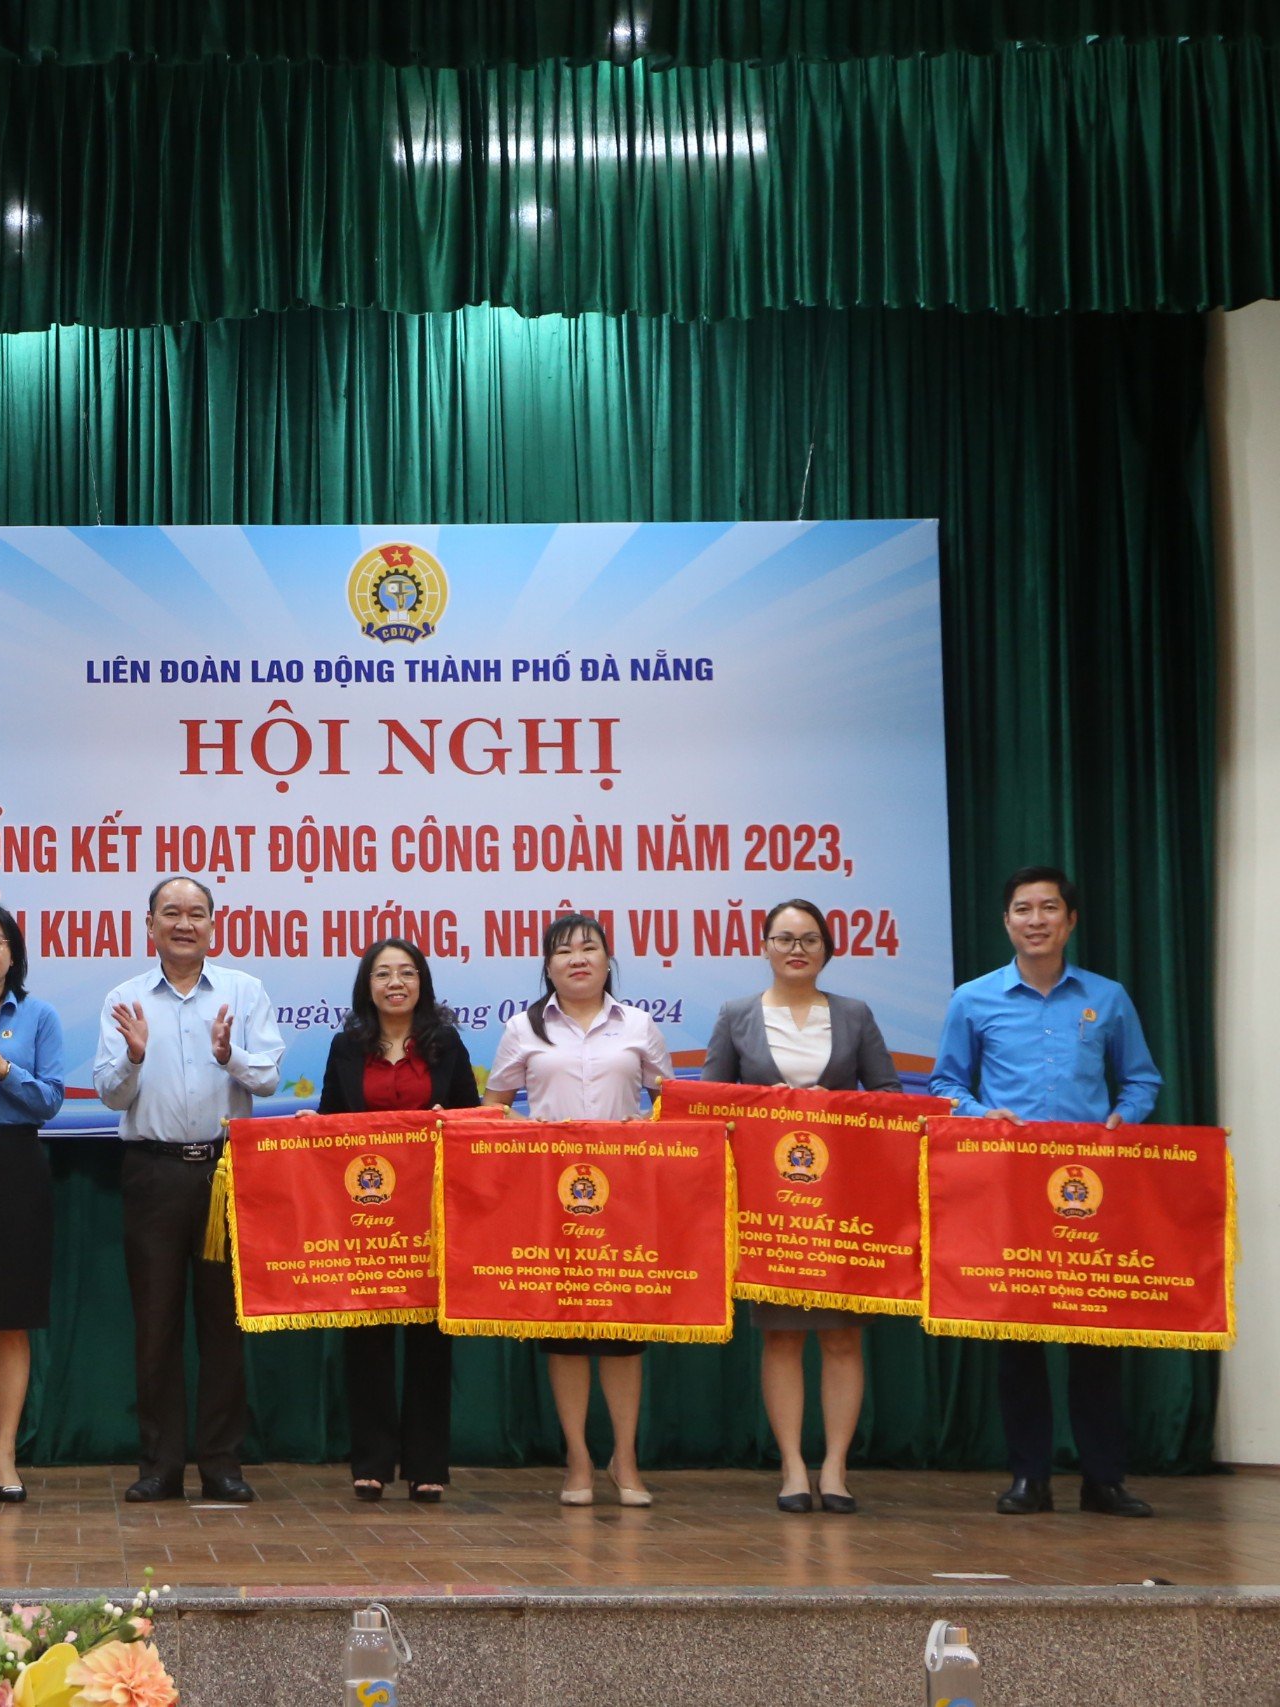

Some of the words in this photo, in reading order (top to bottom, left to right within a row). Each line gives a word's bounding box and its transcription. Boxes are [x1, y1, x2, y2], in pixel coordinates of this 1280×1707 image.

[382, 627, 415, 639] CĐVN
[87, 656, 150, 683] LIÊN
[160, 655, 240, 683] ĐOÀN
[252, 660, 303, 683] LAO
[314, 655, 394, 688] ĐỘNG
[405, 655, 501, 682] THÀNH
[513, 654, 570, 681] PHỐ
[580, 659, 620, 681] ĐÀ
[631, 653, 713, 681] NẴNG
[179, 700, 350, 793] HỘI
[378, 717, 621, 790] NGHỊ
[73, 810, 141, 872] KẾT
[157, 826, 255, 883] HOẠT
[269, 815, 376, 883] ĐỘNG
[393, 815, 499, 872] CÔNG
[514, 815, 622, 871] ĐOÀN
[638, 814, 729, 870] NĂM
[744, 824, 854, 877] 2023,
[42, 910, 132, 957] KHAI
[147, 905, 308, 957] ƯƠNG
[323, 900, 470, 963] HƯỚNG,
[628, 909, 679, 967] VỤ
[825, 909, 899, 956] 024
[277, 999, 350, 1029] ngày
[688, 1102, 710, 1115] LIÊN
[712, 1103, 745, 1117] ĐOÀN
[746, 1106, 768, 1119] LAO
[770, 1106, 804, 1122] ĐỘNG
[805, 1109, 842, 1125] THÀNH
[843, 1112, 867, 1128] PHỐ
[868, 1115, 885, 1129] ĐÀ
[887, 1115, 921, 1133] NẴNG
[256, 1137, 278, 1151] LIÊN
[279, 1136, 311, 1150] ĐOÀN
[312, 1136, 333, 1148] LAO
[334, 1133, 367, 1149] ĐỘNG
[368, 1132, 404, 1145] THÀNH
[405, 1127, 429, 1143] PHỐ
[471, 1140, 492, 1154] LIÊN
[493, 1139, 526, 1153] ĐOÀN
[527, 1141, 549, 1154] LAO
[550, 1140, 583, 1156] ĐỘNG
[585, 1141, 621, 1155] THÀNH
[623, 1140, 647, 1156] PHỐ
[648, 1143, 664, 1156] ĐÀ
[666, 1141, 699, 1157] NẴNG
[956, 1138, 979, 1153] LIÊN
[981, 1140, 1015, 1152] ĐOÀN
[1017, 1141, 1038, 1154] LAO
[1039, 1141, 1075, 1156] ĐỘNG
[1076, 1143, 1116, 1157] THÀNH
[1117, 1143, 1141, 1158] PHỐ
[1143, 1144, 1161, 1159] ĐÀ
[1162, 1144, 1197, 1162] NẴNG
[777, 1189, 823, 1208] Tặng
[350, 1212, 395, 1228] Tặng
[562, 1222, 606, 1239] Tặng
[737, 1210, 762, 1225] ƠN
[767, 1213, 785, 1230] VỊ
[789, 1213, 835, 1231] XUẤT
[838, 1215, 874, 1236] SẮC
[303, 1238, 340, 1253] ĐƠN
[343, 1238, 361, 1253] VỊ
[365, 1231, 409, 1250] XUẤT
[1054, 1224, 1099, 1243] Tặng
[511, 1245, 551, 1260] ĐƠN
[554, 1247, 571, 1263] VỊ
[574, 1243, 619, 1261] XUẤT
[622, 1244, 658, 1263] SẮC
[1001, 1247, 1043, 1262] ĐƠN
[1046, 1250, 1063, 1267] VỊ
[1067, 1247, 1113, 1267] XUẤT
[1117, 1249, 1155, 1269] SẮC
[960, 1266, 1005, 1277] TRONG
[1007, 1267, 1054, 1280] PHONG
[1055, 1269, 1088, 1282] TRÀO
[1089, 1272, 1110, 1283] THI
[1112, 1273, 1140, 1284] ĐUA
[1143, 1274, 1195, 1287] CNVCLĐ
[557, 1296, 583, 1306] NĂM
[585, 1298, 613, 1307] 2023
